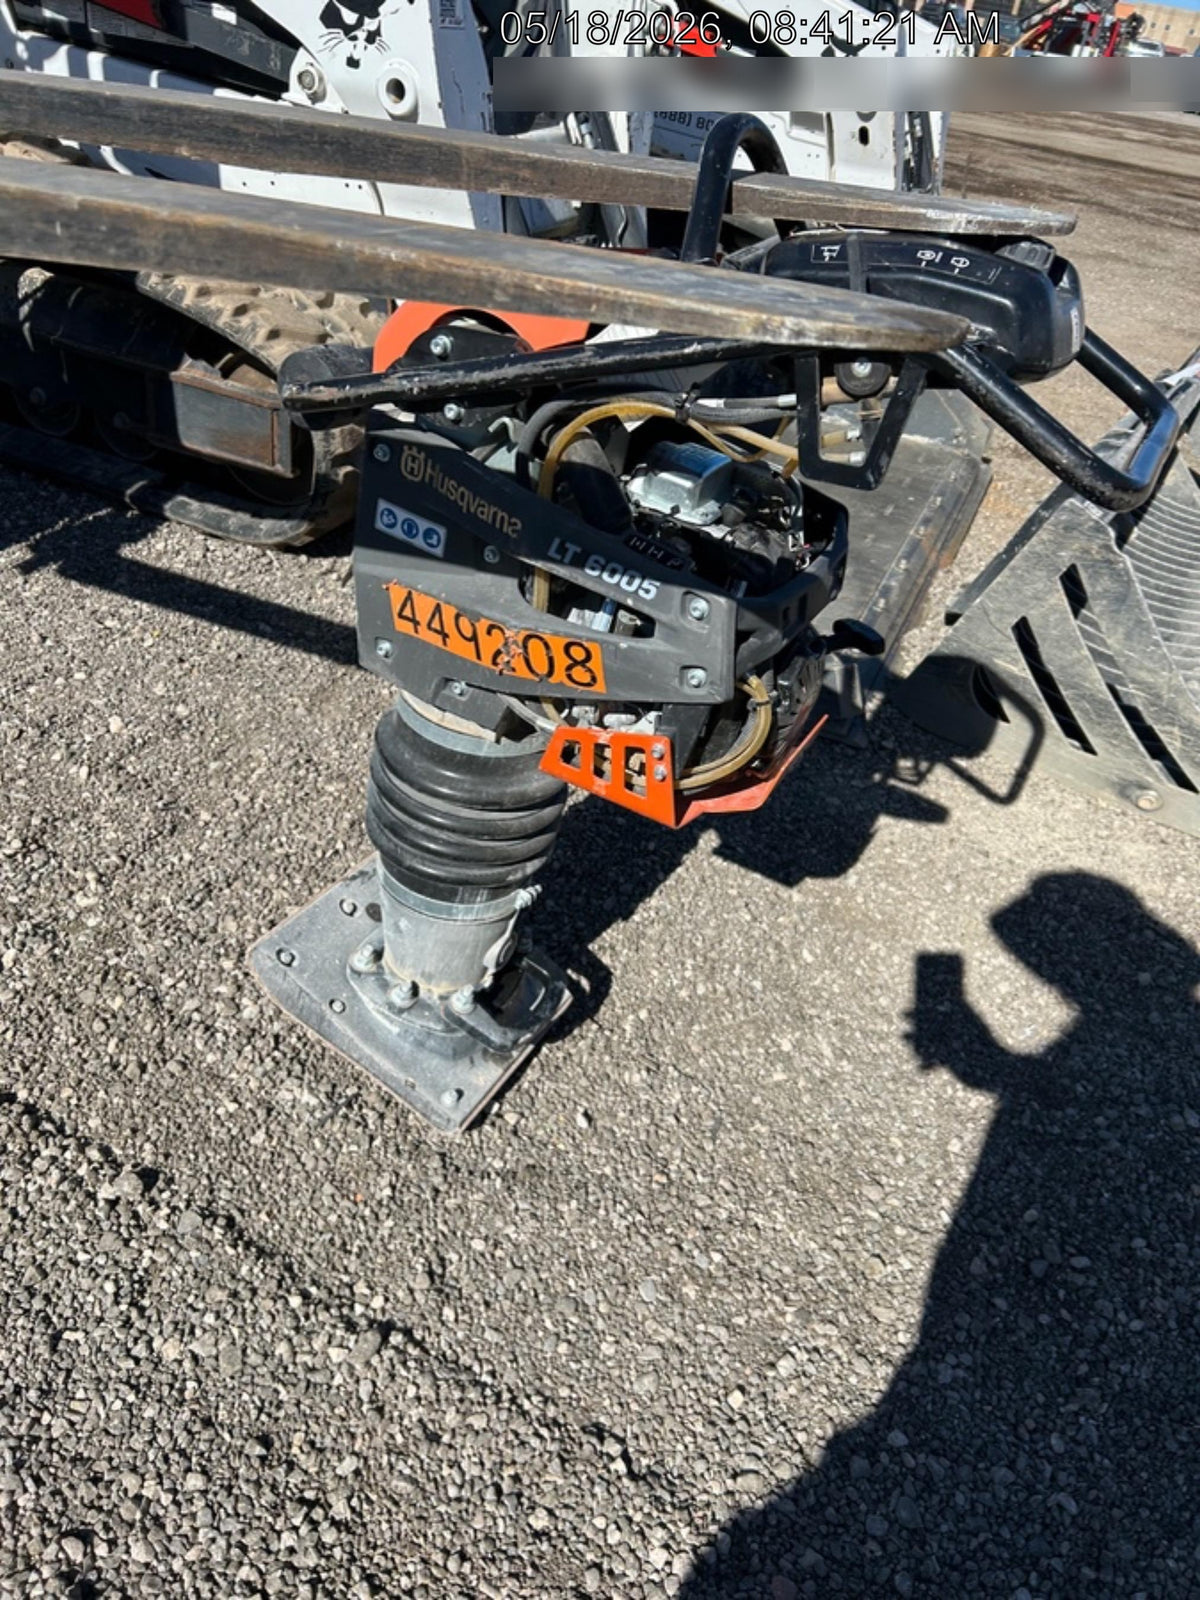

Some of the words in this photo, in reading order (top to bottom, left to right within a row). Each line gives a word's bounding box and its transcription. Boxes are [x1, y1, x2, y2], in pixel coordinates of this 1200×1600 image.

[425, 458, 522, 538] Husqvarna
[547, 537, 582, 565] LT
[584, 554, 661, 600] 6005
[397, 589, 598, 687] 449208
